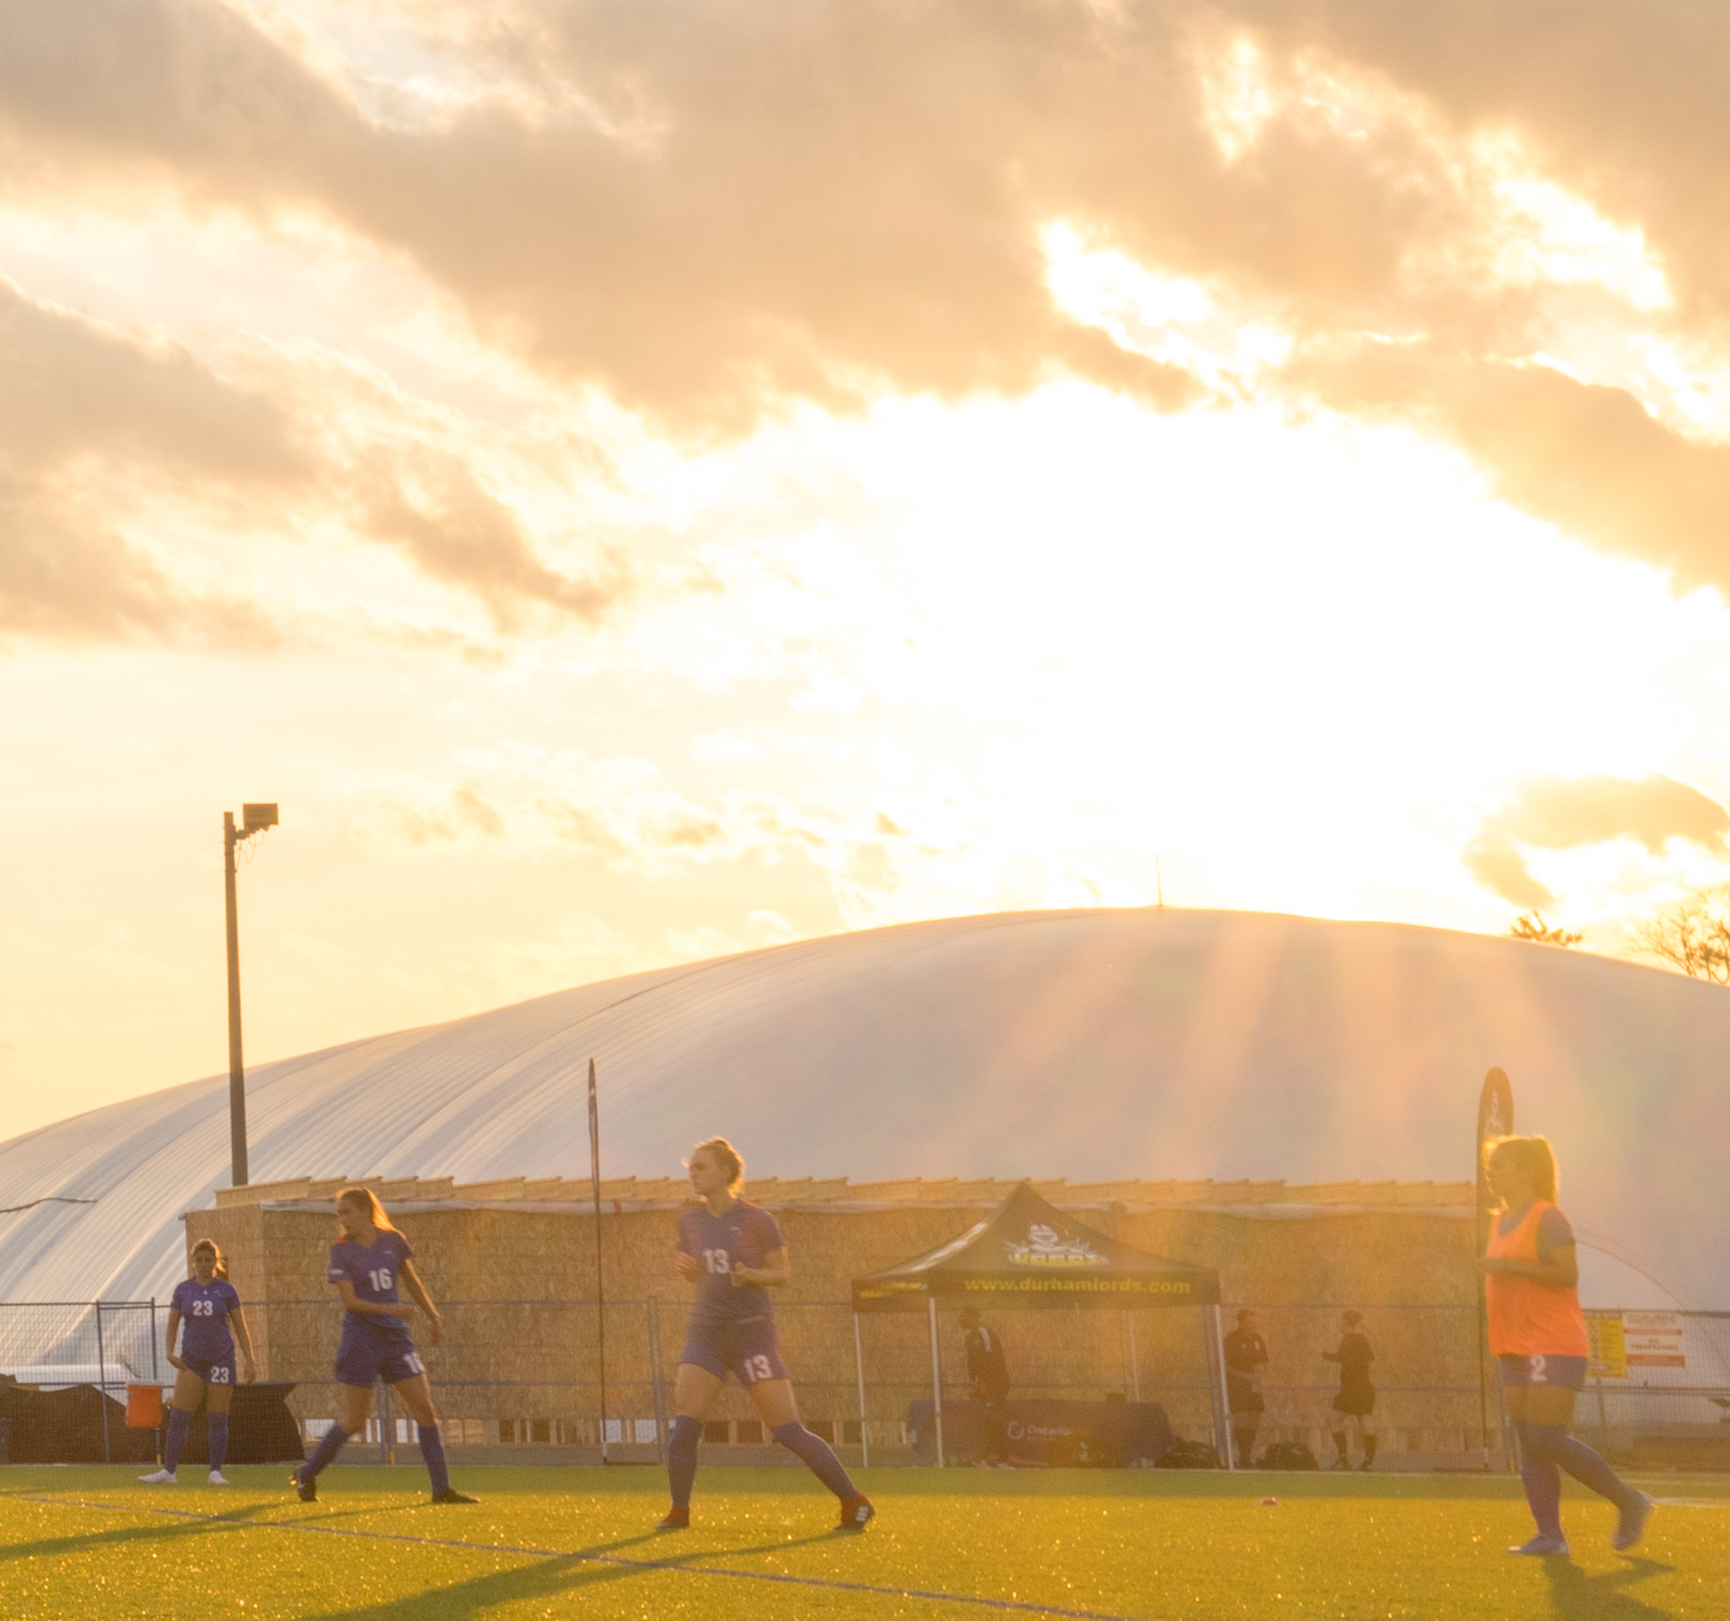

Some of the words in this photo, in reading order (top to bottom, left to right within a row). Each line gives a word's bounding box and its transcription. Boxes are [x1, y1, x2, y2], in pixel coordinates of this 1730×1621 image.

[703, 1248, 730, 1274] 13
[369, 1267, 392, 1292] 16
[192, 1300, 213, 1317] 23
[211, 1366, 229, 1383] 23
[744, 1354, 773, 1382] 13
[1530, 1353, 1547, 1382] 2
